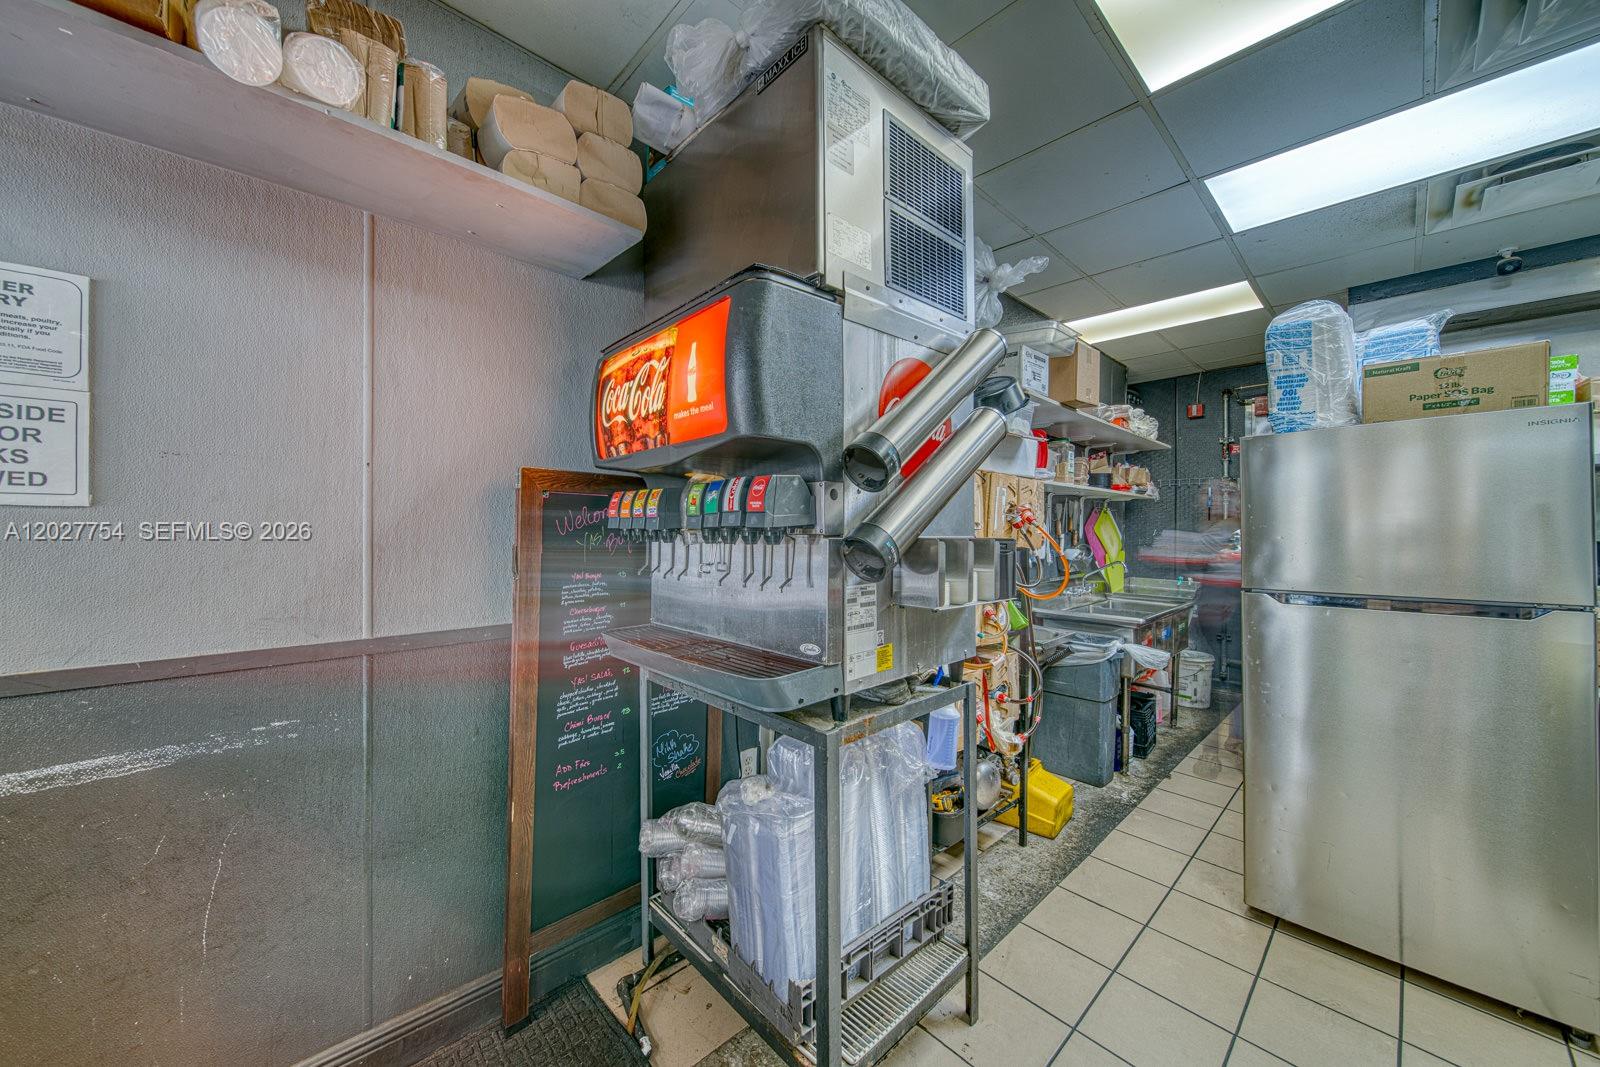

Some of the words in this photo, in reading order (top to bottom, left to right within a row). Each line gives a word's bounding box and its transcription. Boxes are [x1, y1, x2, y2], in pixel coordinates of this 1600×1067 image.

[764, 52, 789, 83] MAXX
[791, 37, 805, 59] ICE
[3, 280, 34, 296] ER
[1, 318, 37, 328] increase
[1372, 366, 1396, 375] Natural
[602, 356, 671, 428] Coca-Cola
[1409, 392, 1442, 402] Paper
[1471, 386, 1495, 395] Bag
[0, 402, 65, 423] SIDE
[673, 409, 690, 420] makes
[690, 407, 699, 416] the
[700, 400, 714, 413] meal
[1528, 417, 1582, 426] INSIGNIA
[0, 425, 42, 443] OR
[0, 470, 48, 487] ED
